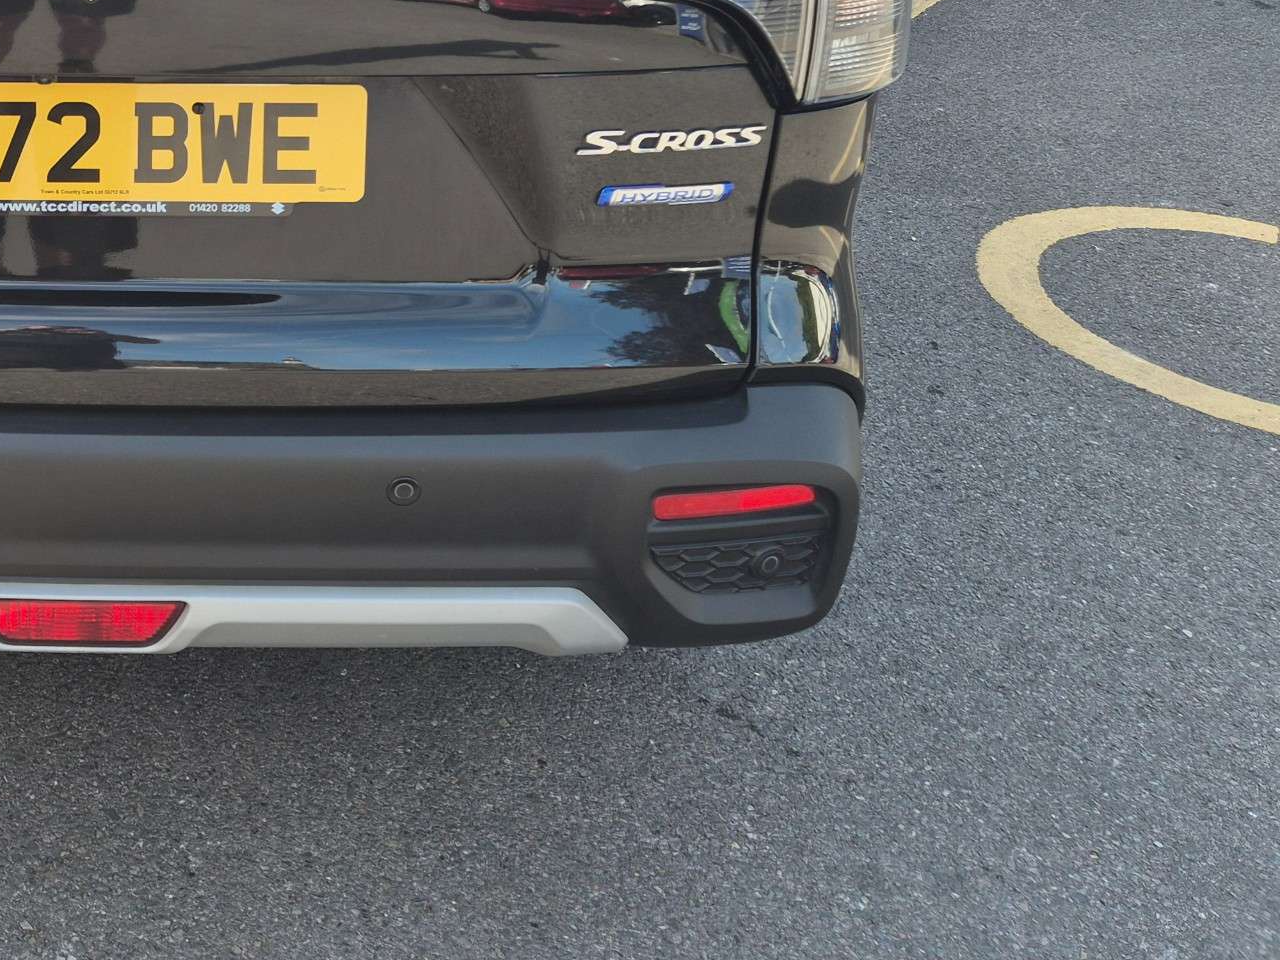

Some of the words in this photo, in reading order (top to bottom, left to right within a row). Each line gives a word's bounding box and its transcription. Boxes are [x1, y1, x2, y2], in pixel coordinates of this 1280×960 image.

[133, 102, 320, 185] BWE
[576, 125, 768, 156] S-CROSS
[620, 188, 716, 203] HYBRID
[189, 203, 218, 213] 01420
[221, 203, 251, 213] 82288
